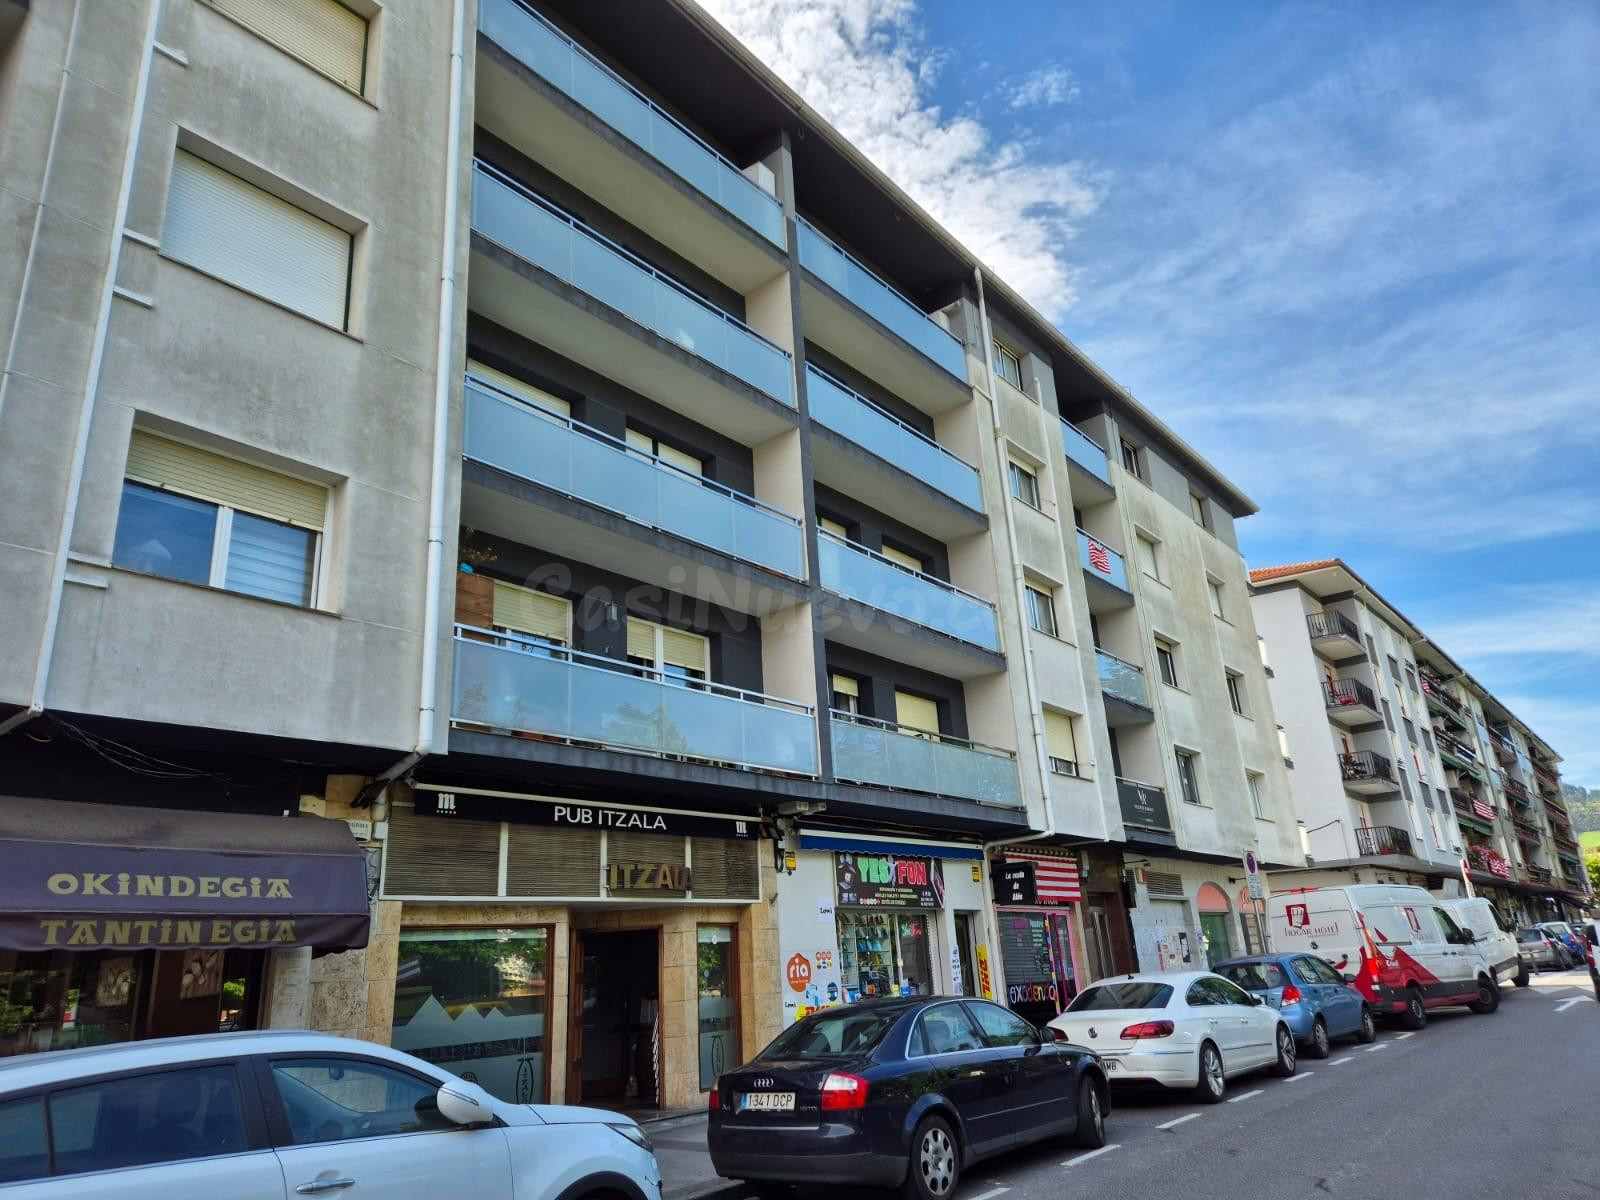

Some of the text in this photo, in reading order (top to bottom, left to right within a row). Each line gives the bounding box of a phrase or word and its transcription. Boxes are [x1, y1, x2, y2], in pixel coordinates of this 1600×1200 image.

[554, 806, 667, 830] PUB ITZALA
[857, 857, 927, 885] YES FON
[790, 957, 809, 978] ria
[979, 958, 991, 994] DHL
[748, 1094, 792, 1108] 1341 DCP
